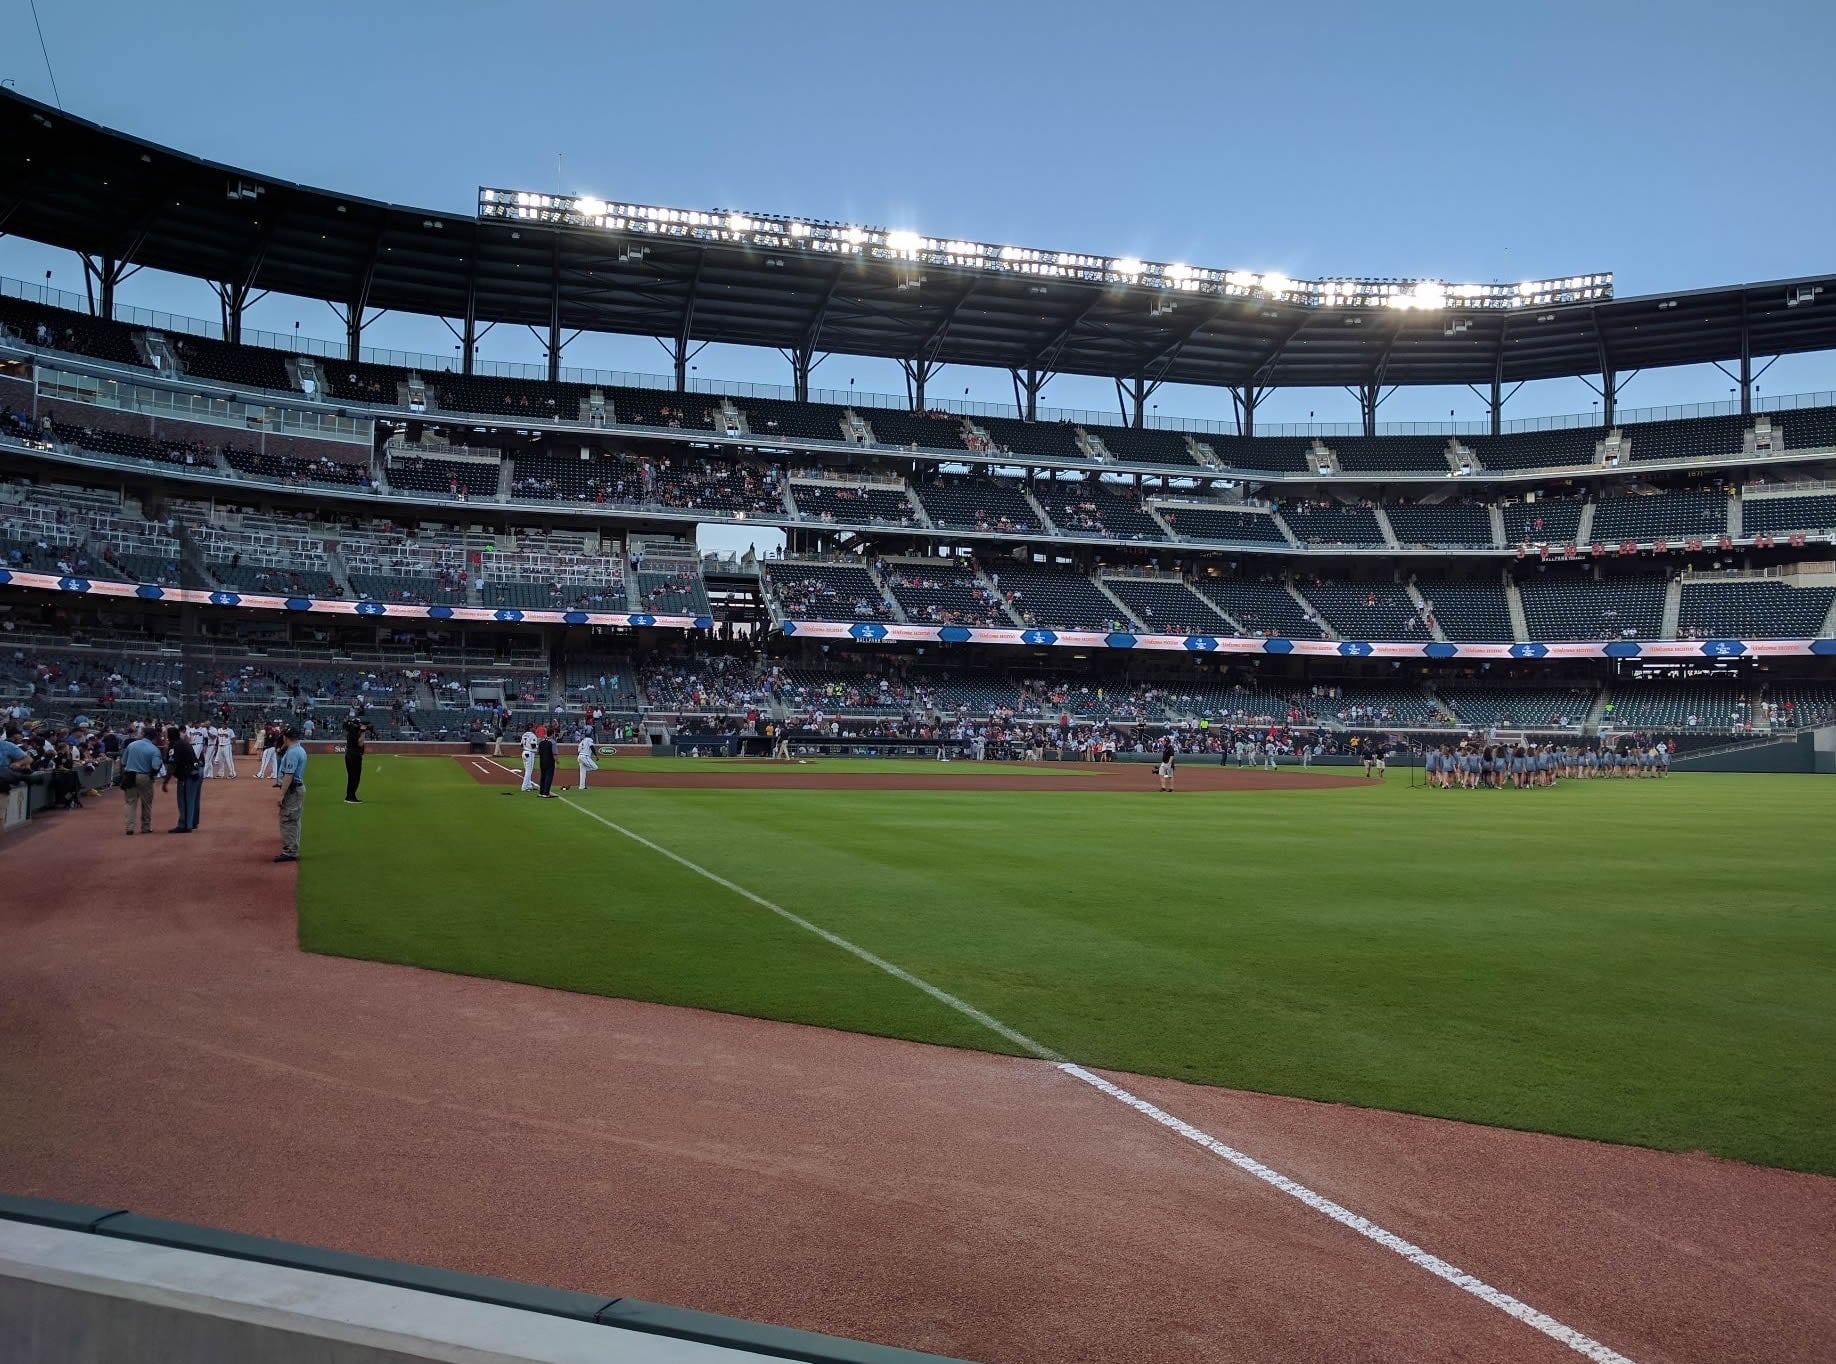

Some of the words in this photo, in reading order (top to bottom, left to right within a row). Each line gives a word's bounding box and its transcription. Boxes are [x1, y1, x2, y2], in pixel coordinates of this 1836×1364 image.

[1619, 541, 1637, 554] 29
[1685, 537, 1703, 551] 35
[1755, 536, 1775, 548] 44
